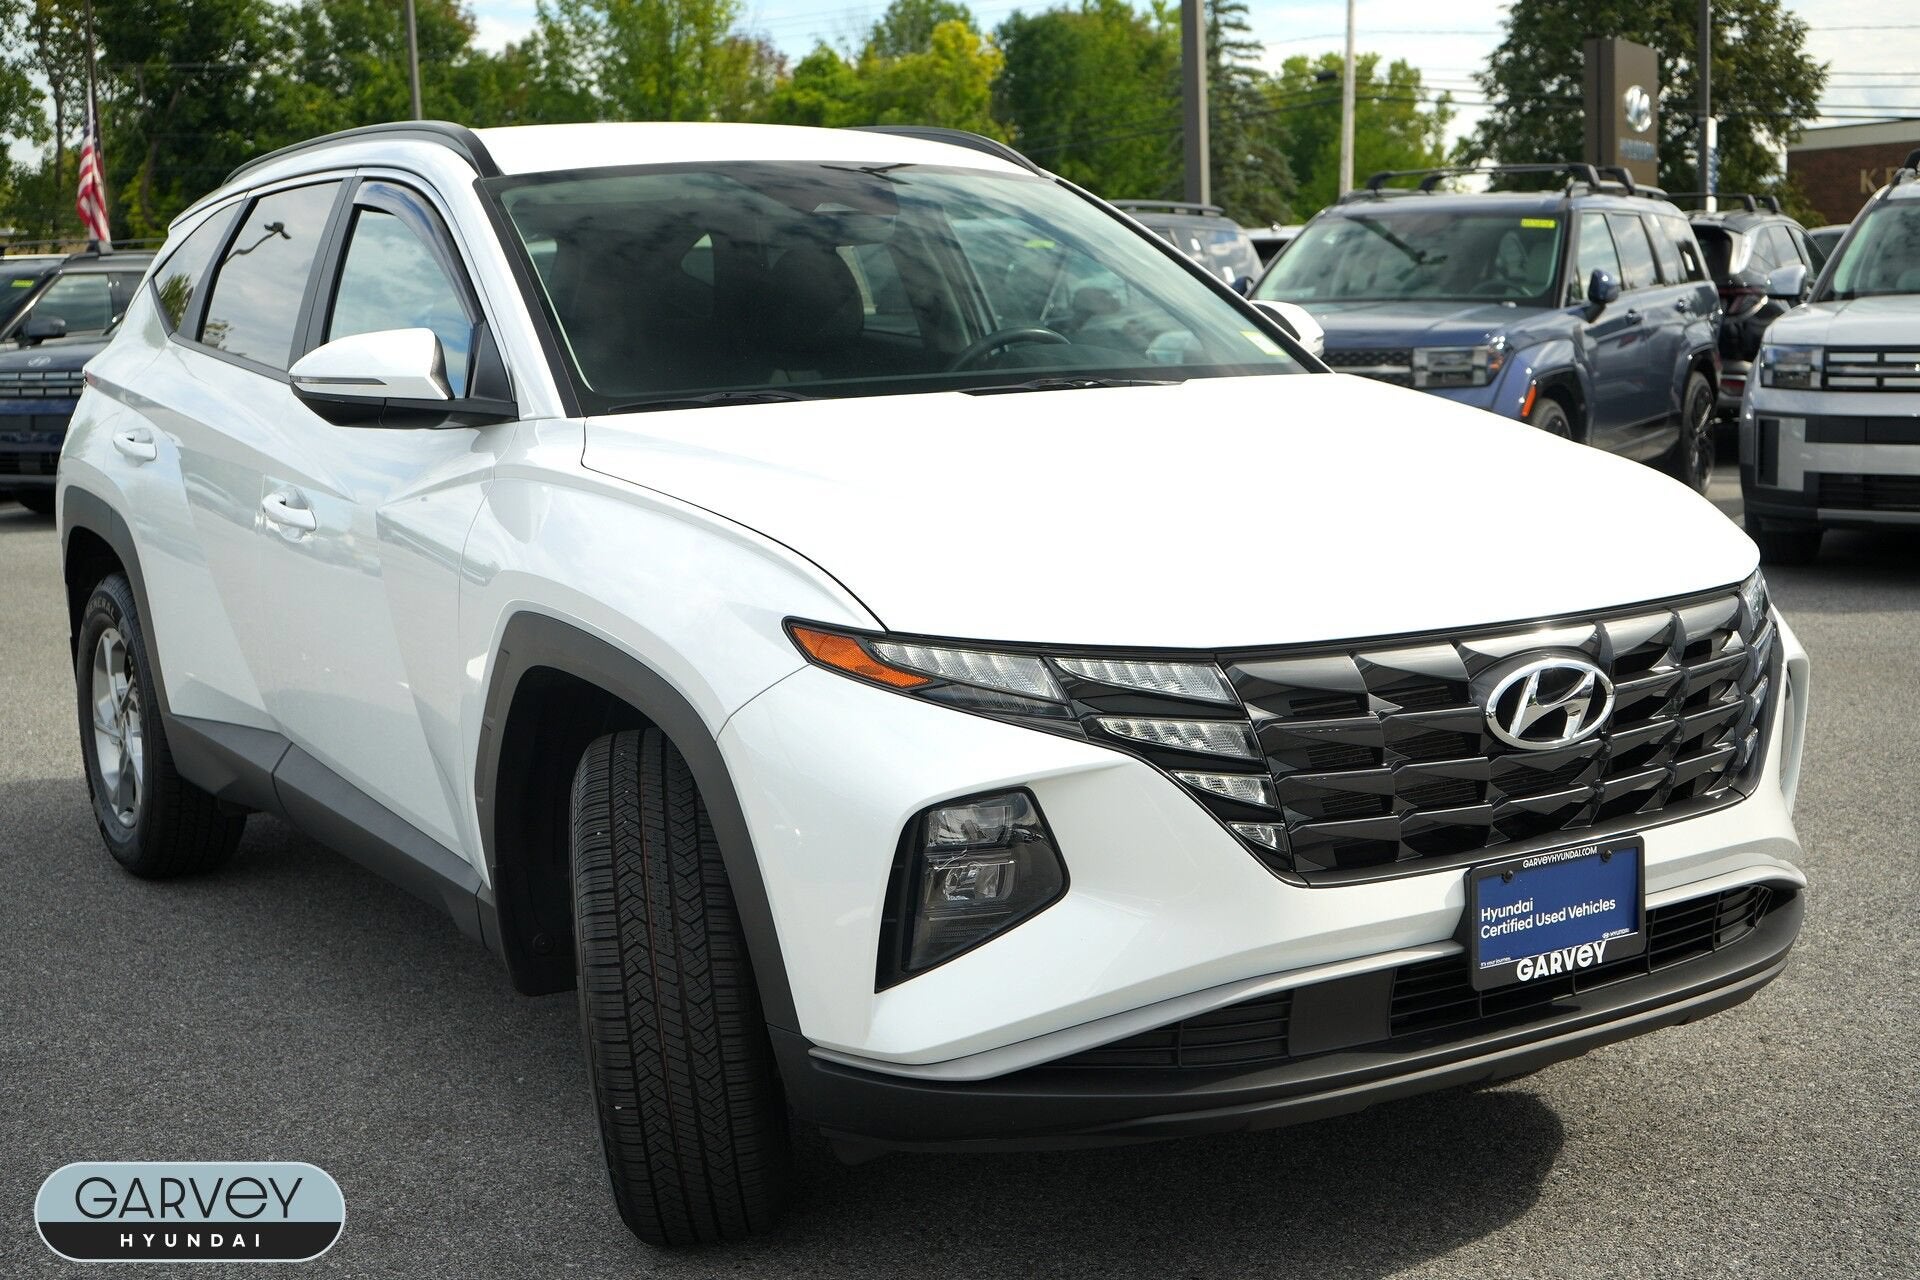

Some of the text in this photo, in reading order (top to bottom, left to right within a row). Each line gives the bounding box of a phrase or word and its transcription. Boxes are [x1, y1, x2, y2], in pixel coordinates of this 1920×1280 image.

[1480, 898, 1534, 922] Hyundai
[1480, 898, 1616, 939] Certified Used Vehicles
